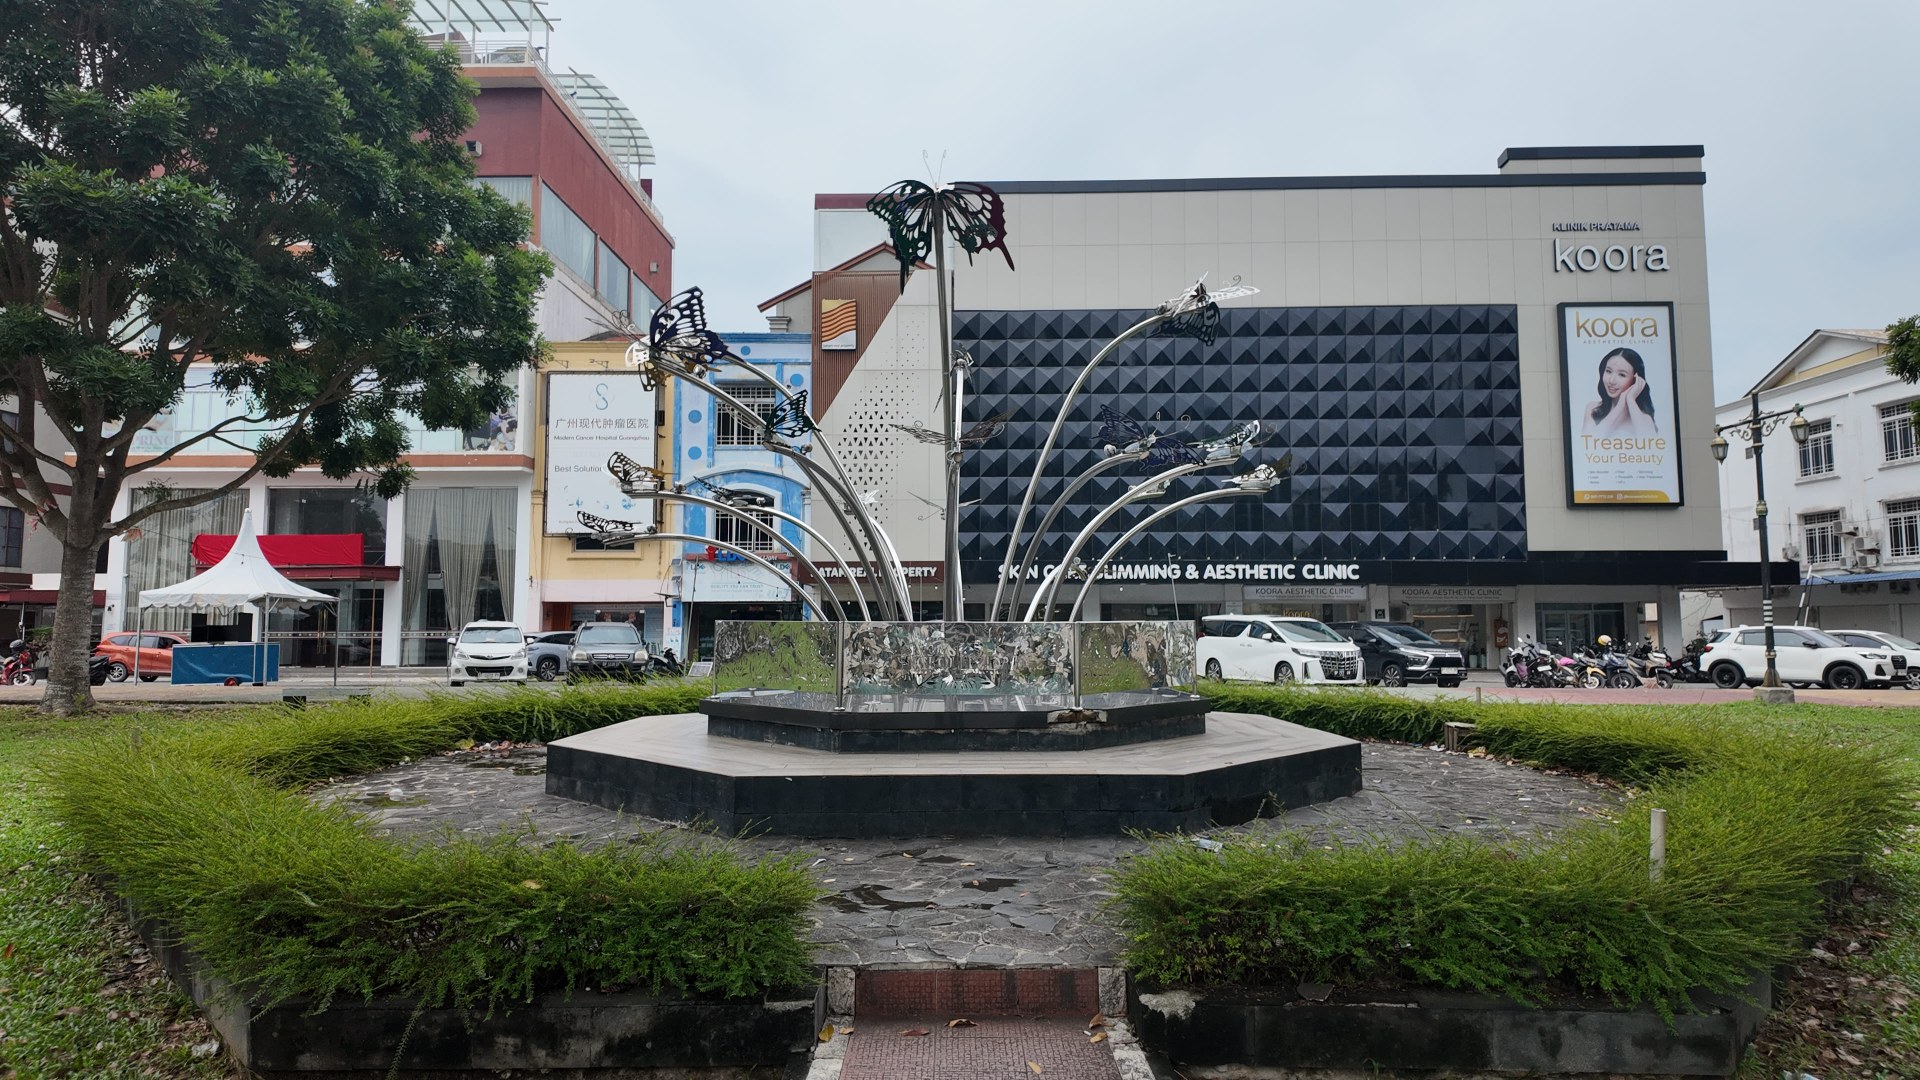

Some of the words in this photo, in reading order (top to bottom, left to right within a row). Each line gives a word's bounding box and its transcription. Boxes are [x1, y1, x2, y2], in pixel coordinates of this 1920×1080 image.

[1552, 222, 1588, 232] KLINIK
[1590, 222, 1640, 232] PRATAMA
[1554, 238, 1670, 273] koora
[1575, 310, 1659, 338] koora
[555, 418, 649, 429] 广州现代肿瘤医院
[1581, 434, 1666, 450] Treasure
[1585, 453, 1614, 464] Your
[1618, 452, 1664, 465] Beauty
[554, 465, 572, 473] Best
[849, 567, 878, 578] REL
[879, 566, 938, 577] PERTY
[997, 564, 1038, 580] SKN
[1185, 564, 1199, 580] &
[1203, 564, 1296, 580] AESTHETIC
[1301, 564, 1360, 580] CLINIC
[1329, 587, 1355, 595] CLINIC
